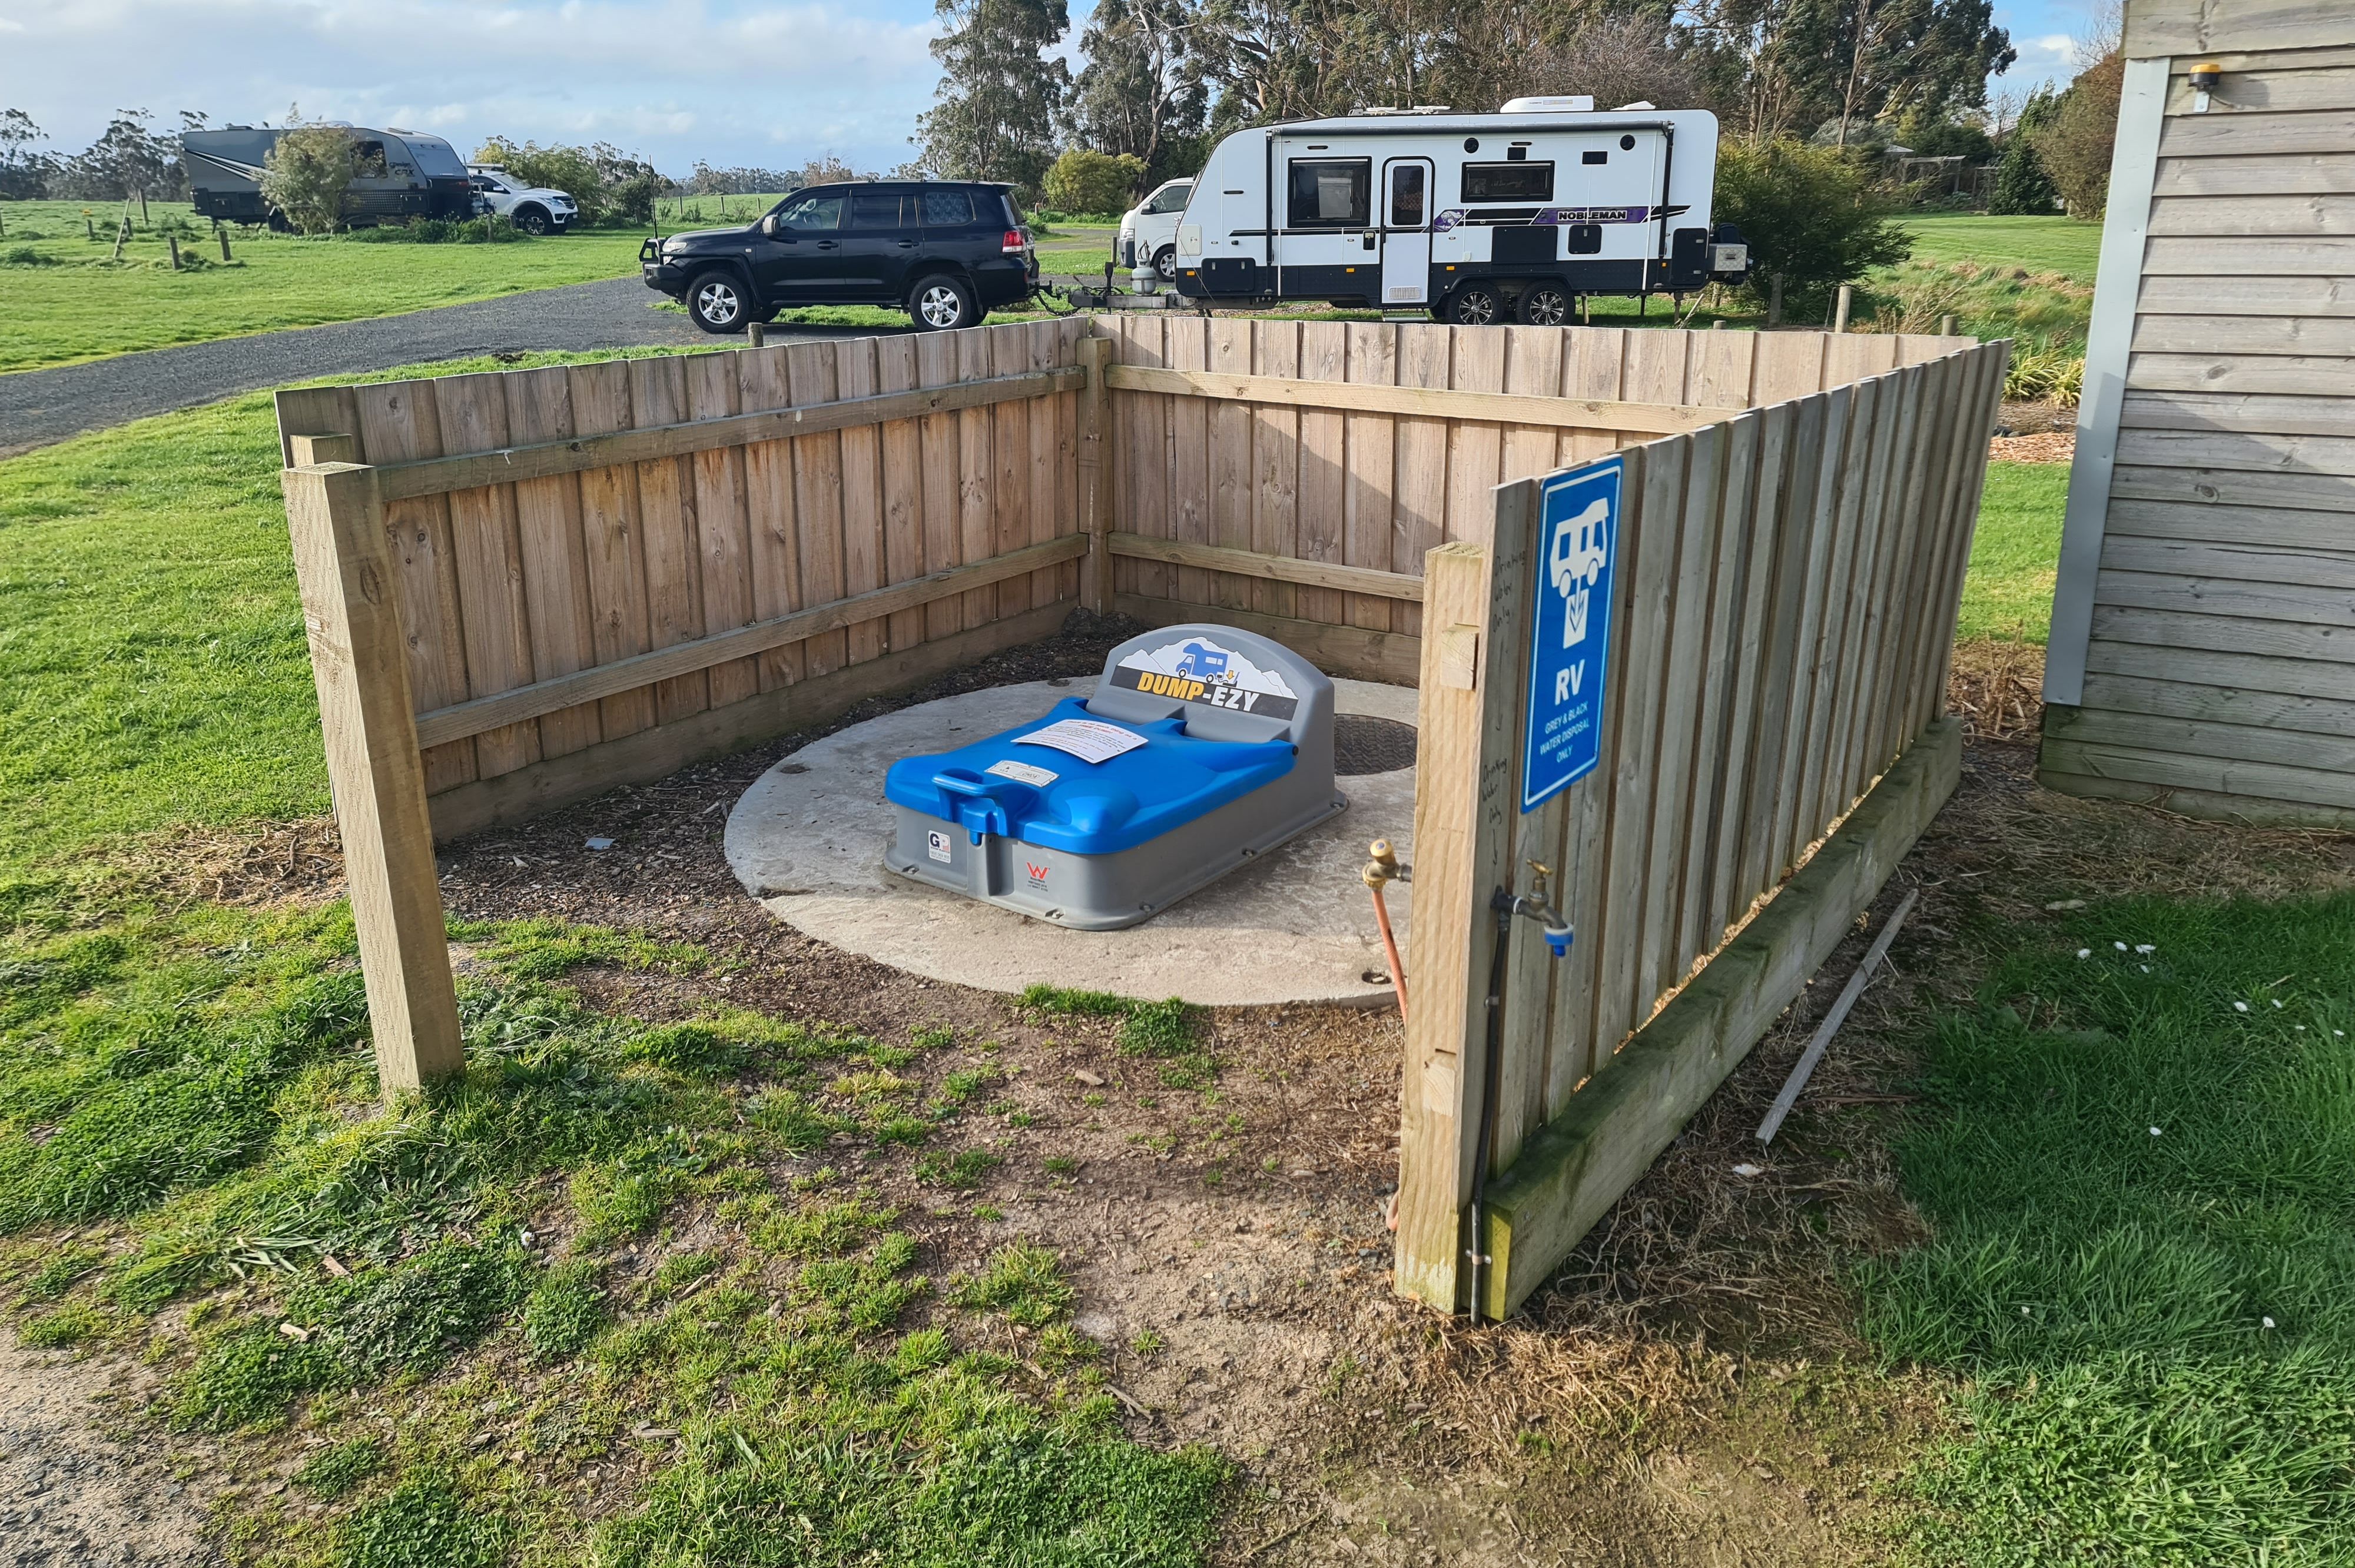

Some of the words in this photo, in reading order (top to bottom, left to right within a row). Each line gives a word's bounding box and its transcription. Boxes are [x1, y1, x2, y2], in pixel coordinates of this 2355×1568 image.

[1557, 210, 1627, 221] NOBLEMAN
[1137, 672, 1259, 712] DUMP-EZY
[1555, 659, 1585, 706] RV
[1545, 715, 1563, 735] GREY
[1562, 713, 1568, 725] &
[1568, 700, 1588, 721] BLACK
[1540, 734, 1561, 756] WATER
[1561, 717, 1590, 743] DISPOSAL
[1556, 745, 1573, 763] ONLY
